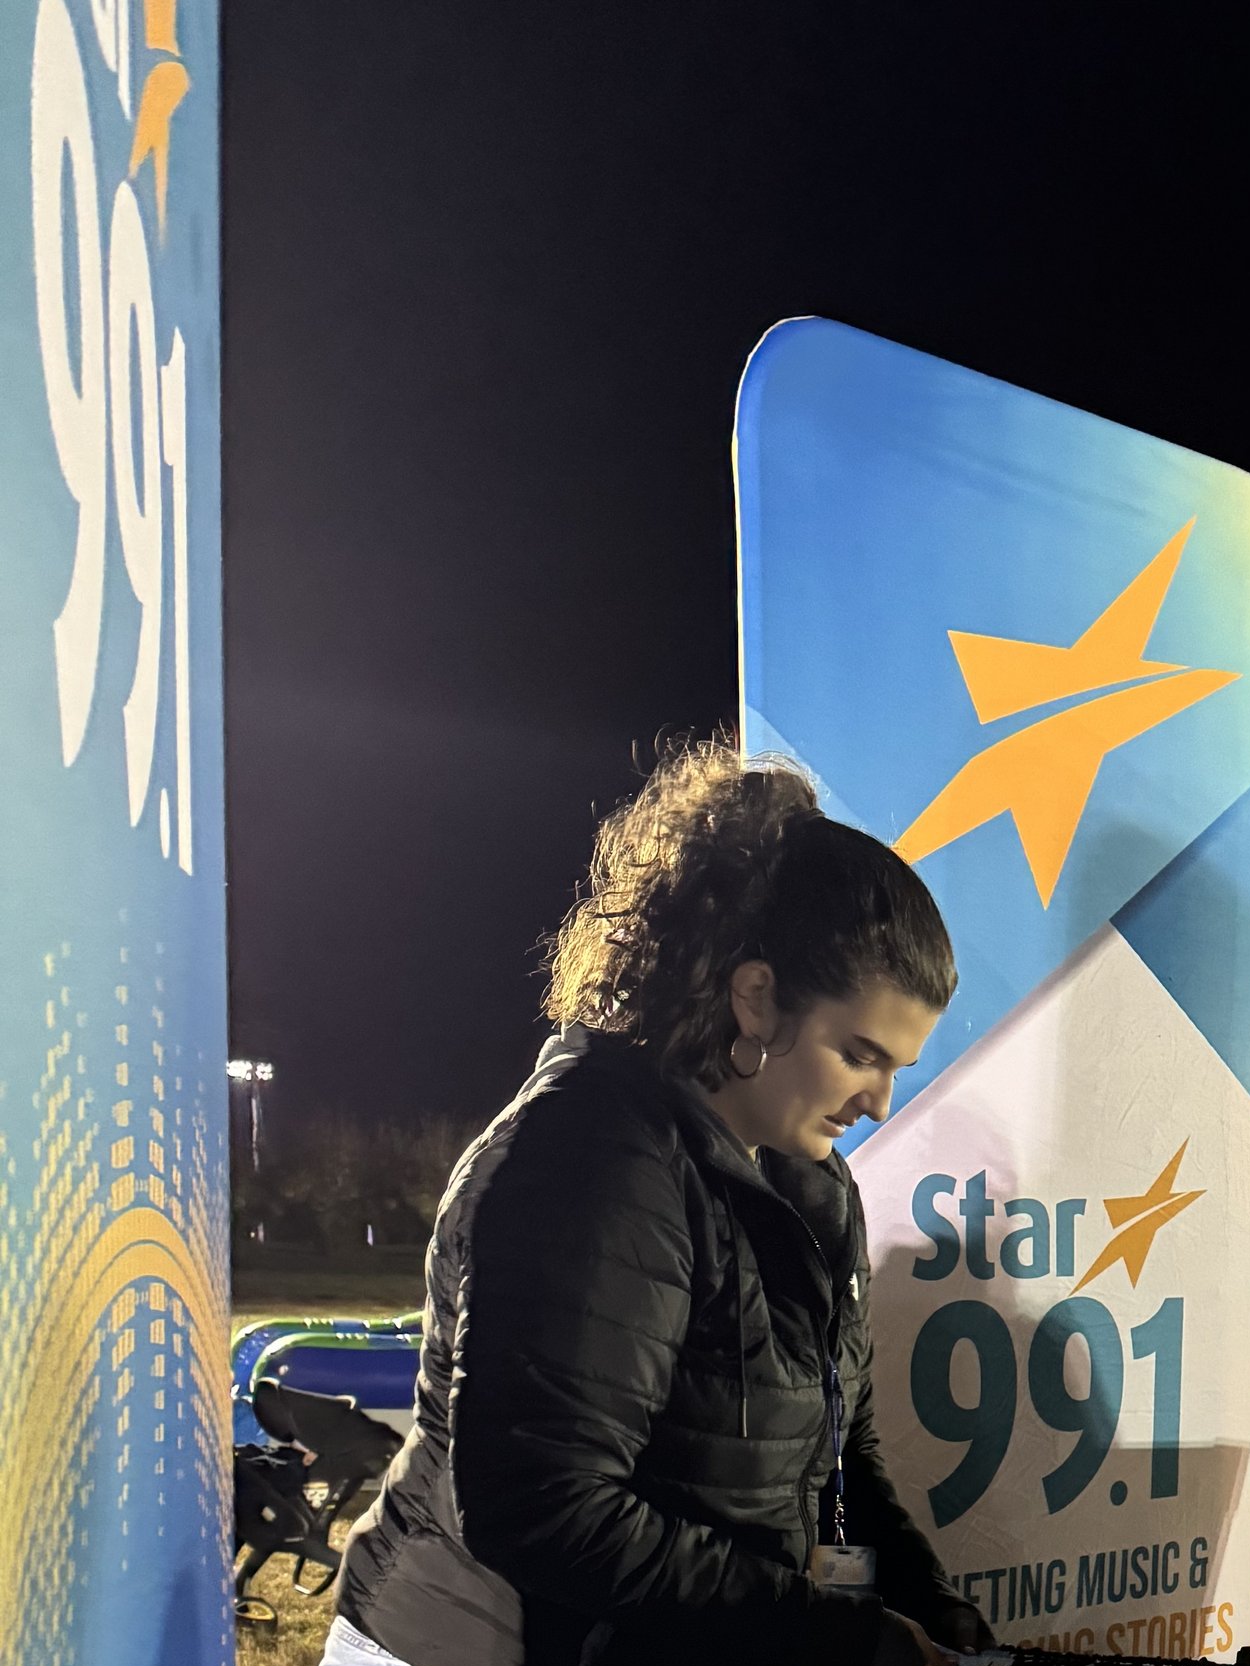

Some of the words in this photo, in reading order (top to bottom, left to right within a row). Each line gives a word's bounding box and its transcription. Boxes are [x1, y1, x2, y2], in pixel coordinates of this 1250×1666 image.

[911, 1168, 1087, 1282] Star
[910, 1296, 1185, 1529] 99.1
[1075, 1540, 1180, 1609] MUSIC
[1188, 1536, 1209, 1589] &
